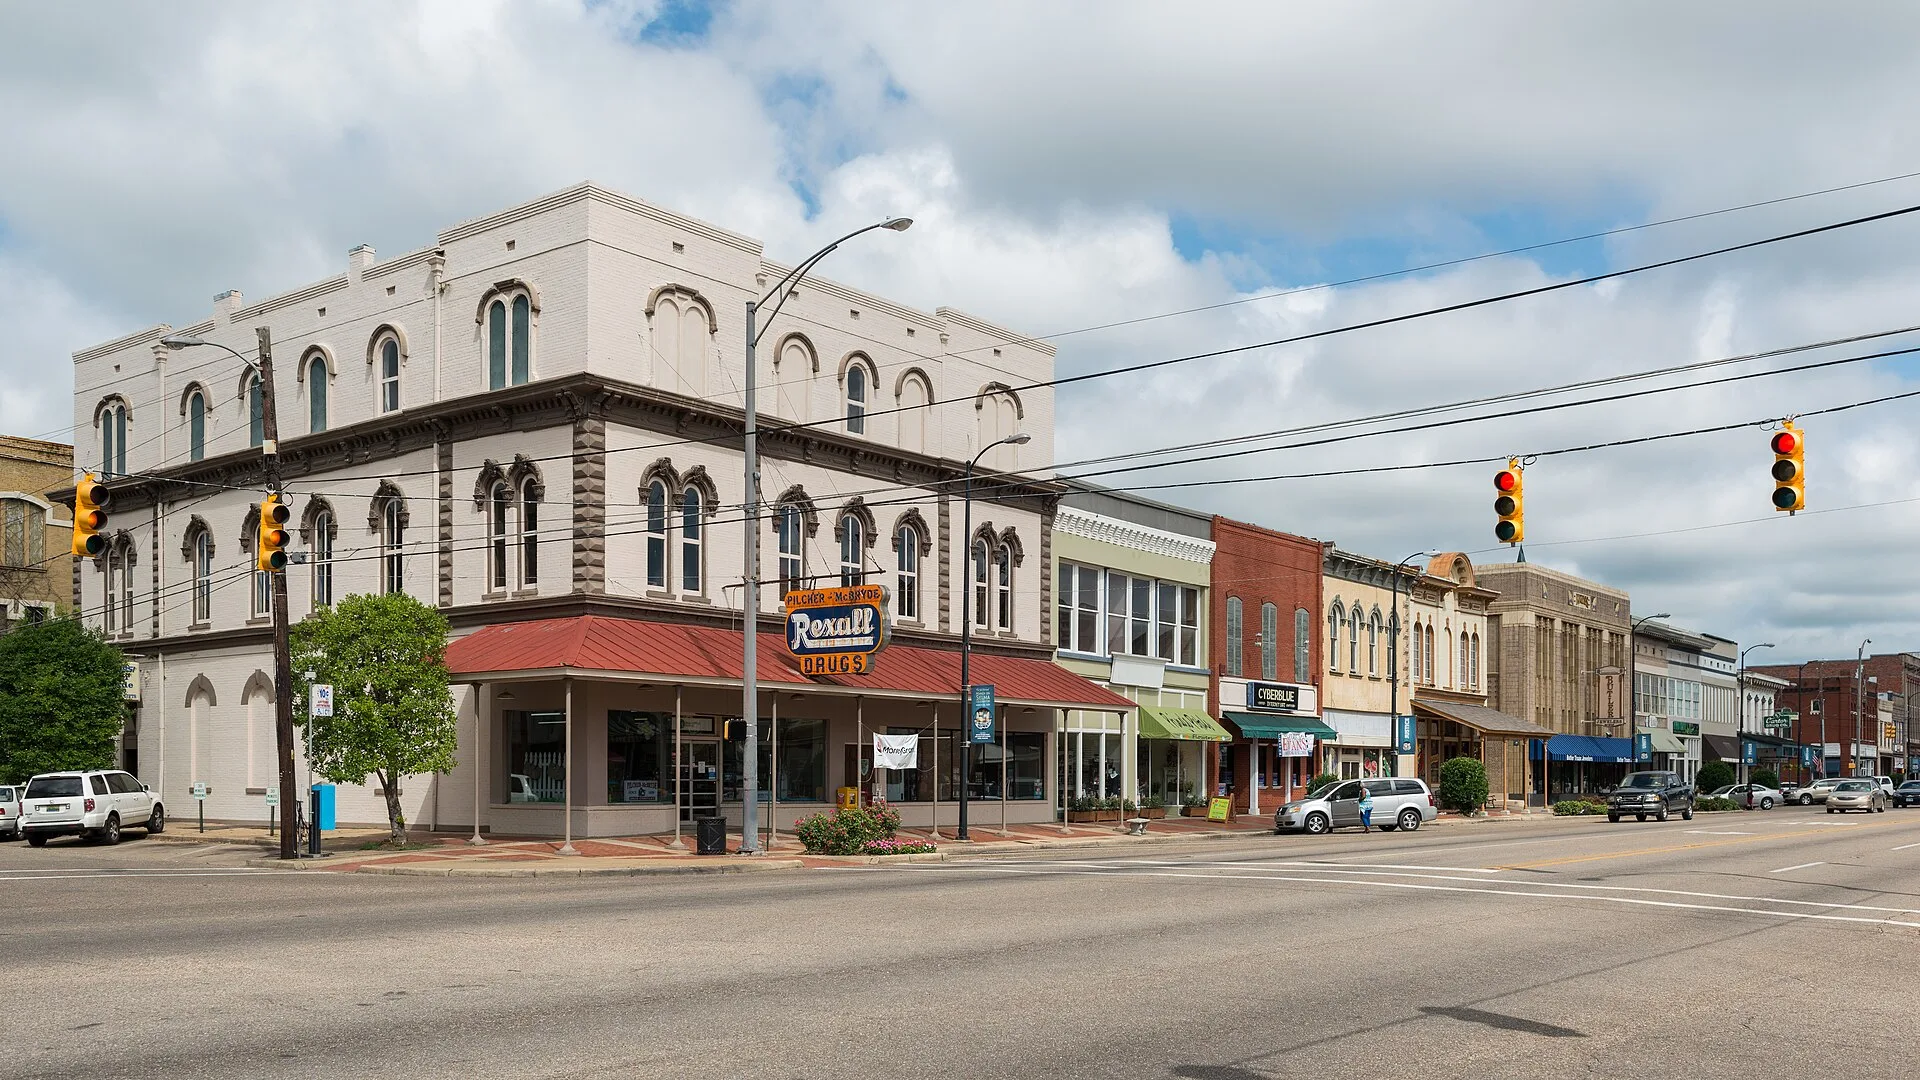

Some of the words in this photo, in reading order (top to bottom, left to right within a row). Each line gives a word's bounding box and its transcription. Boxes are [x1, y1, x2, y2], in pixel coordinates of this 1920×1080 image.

[787, 592, 825, 606] PILCHER
[835, 588, 880, 603] McBRYDE
[791, 608, 875, 650] Rexall
[804, 655, 862, 674] DRUGS
[1258, 688, 1294, 702] CYBERBLUE
[1606, 676, 1614, 718] BUTLER
[882, 746, 914, 756] MoneyGra
[1283, 738, 1306, 750] EVANS
